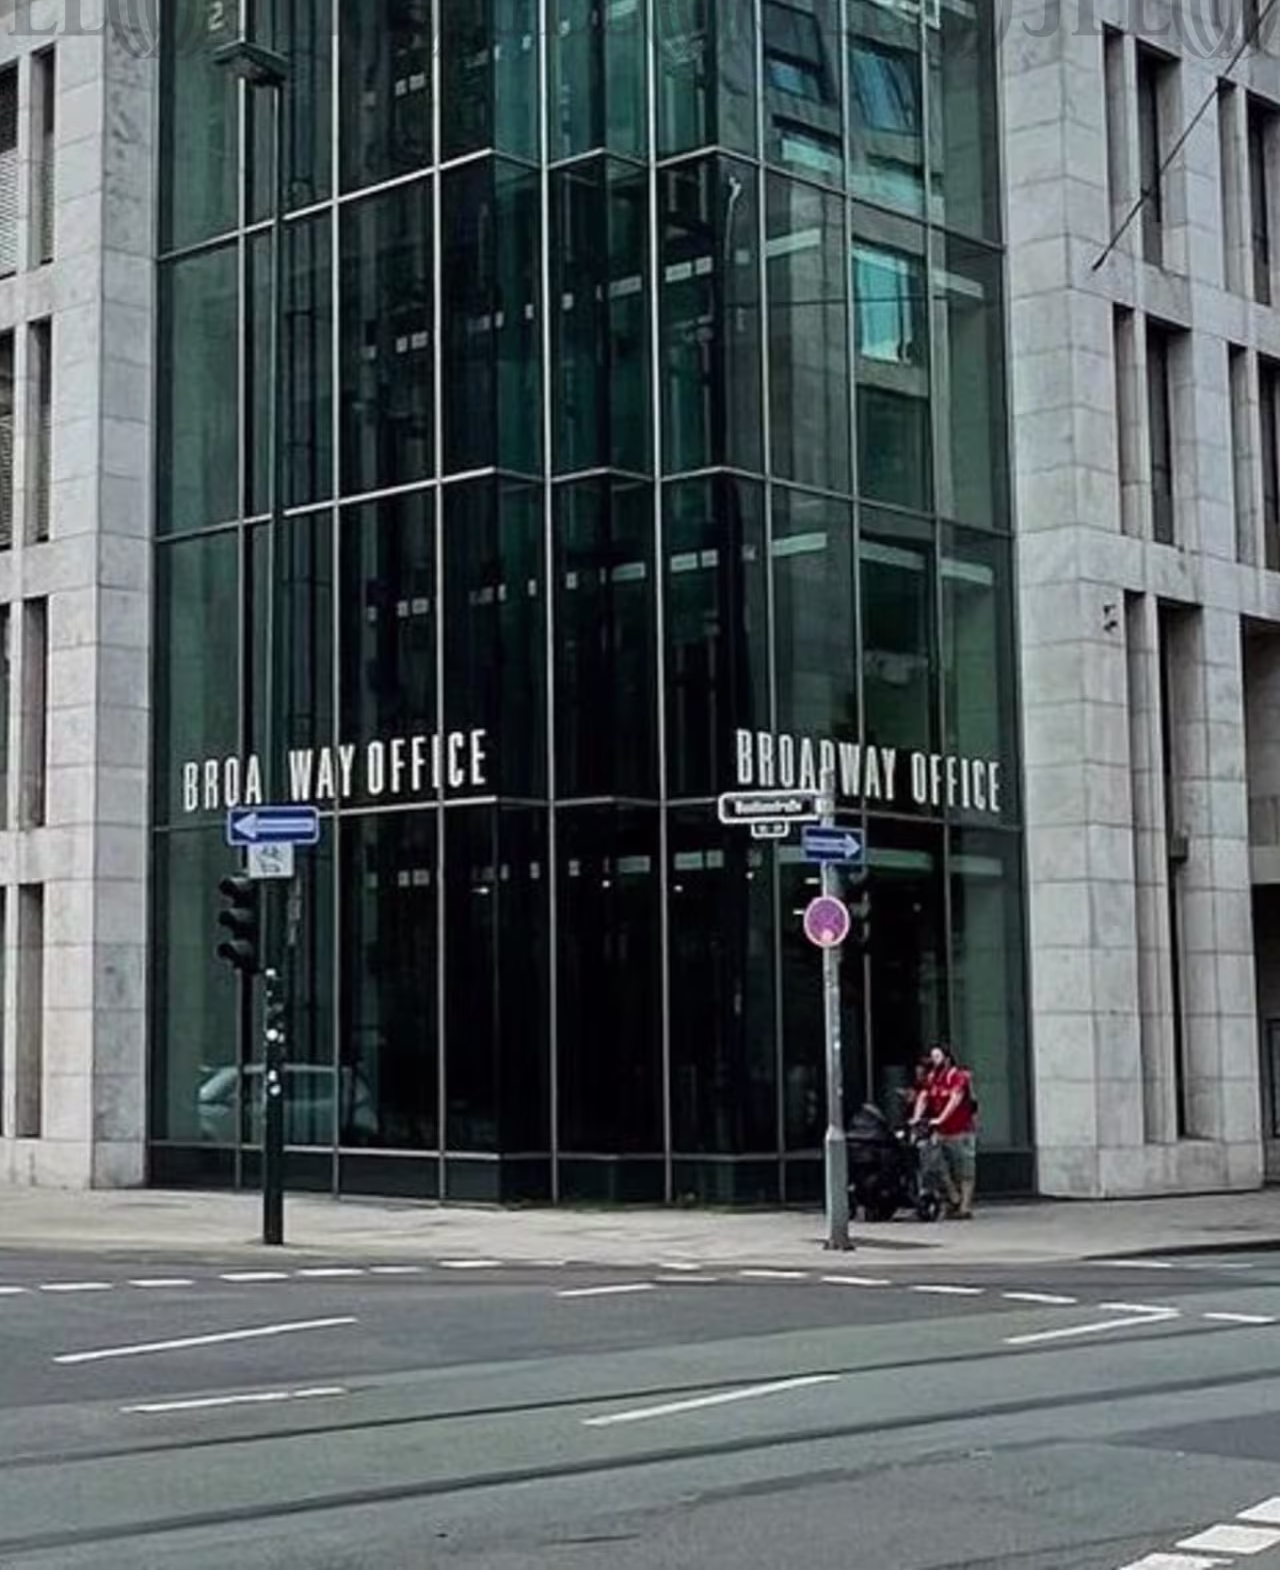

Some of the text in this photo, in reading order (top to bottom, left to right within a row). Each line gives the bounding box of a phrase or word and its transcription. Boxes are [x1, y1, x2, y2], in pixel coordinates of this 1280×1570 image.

[183, 729, 486, 812] BROAWAY OFFICE
[911, 752, 1000, 812] OFFICE
